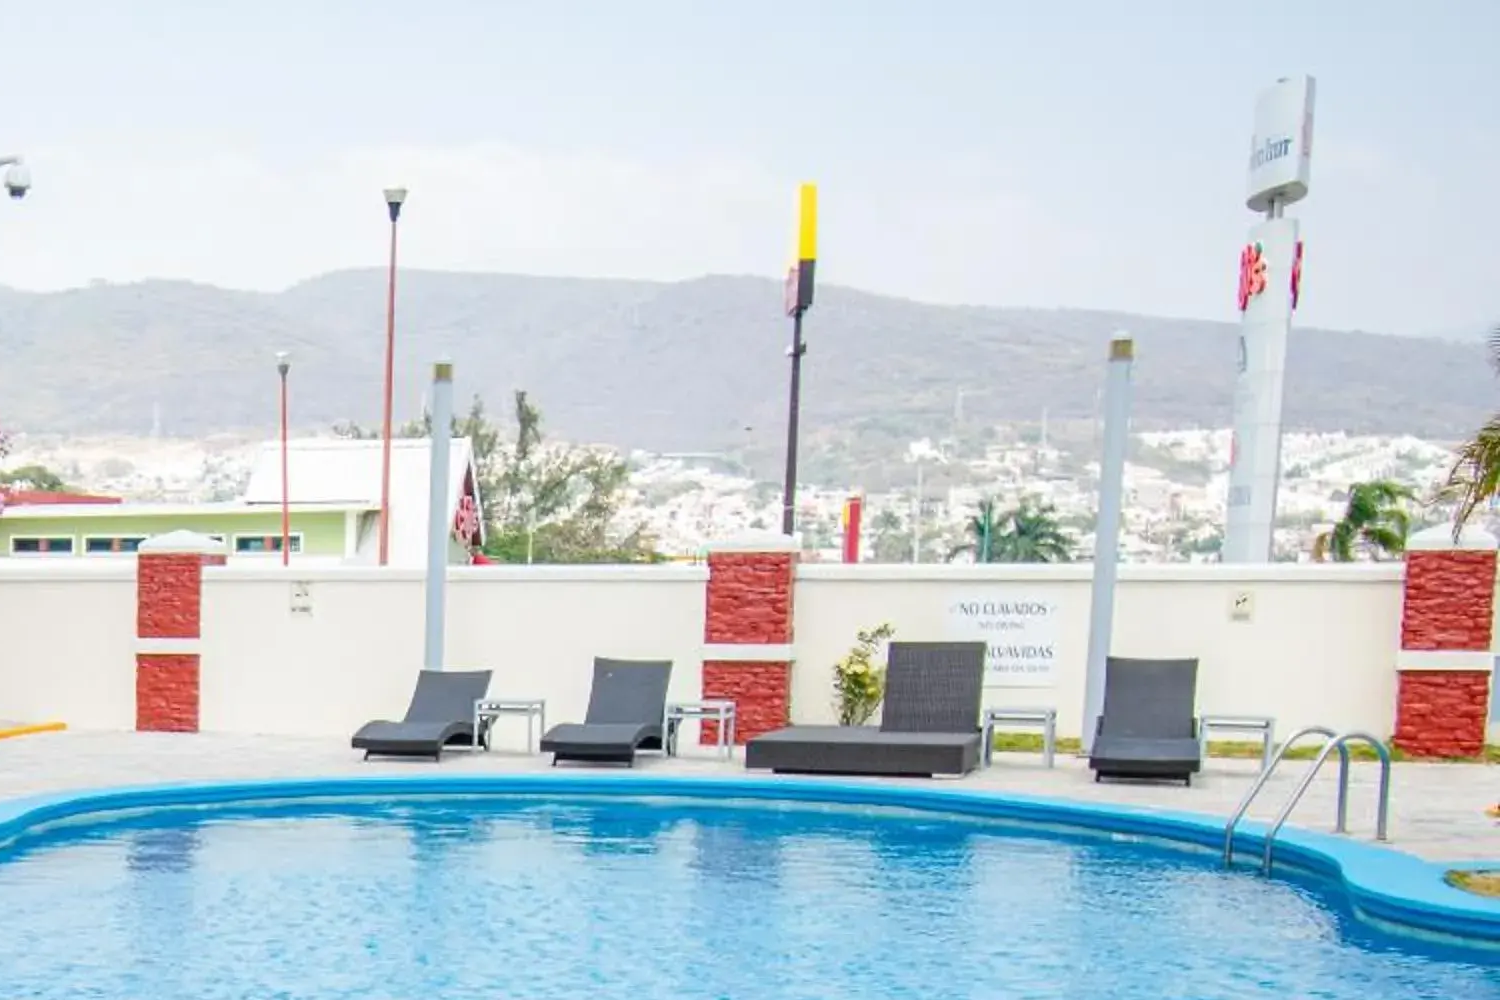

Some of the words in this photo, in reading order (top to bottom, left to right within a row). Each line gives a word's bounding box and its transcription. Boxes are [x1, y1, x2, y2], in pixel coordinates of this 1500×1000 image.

[960, 602, 979, 616] NO
[982, 602, 1048, 616] CLAVADOS
[985, 645, 1054, 659] ALVAVIDAS
